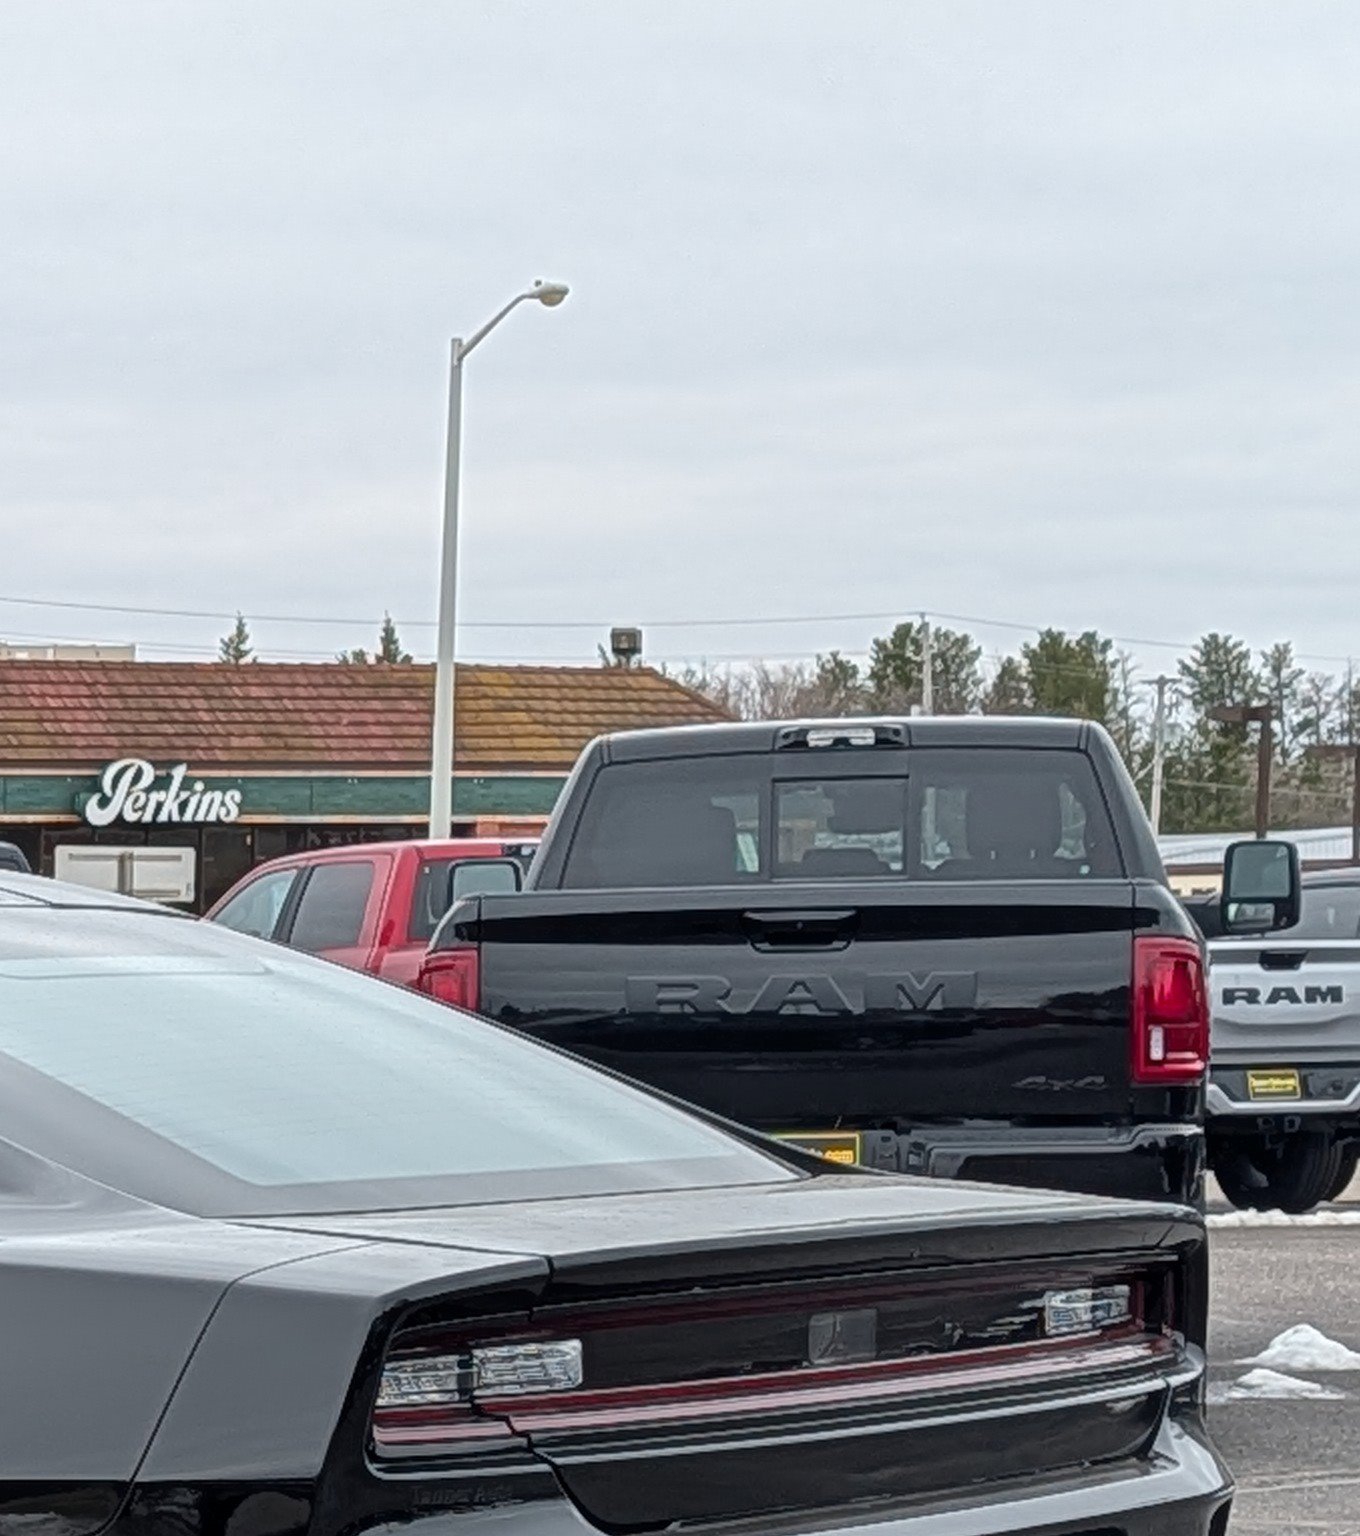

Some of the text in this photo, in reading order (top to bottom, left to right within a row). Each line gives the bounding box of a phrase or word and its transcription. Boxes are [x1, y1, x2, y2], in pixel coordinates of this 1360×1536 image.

[84, 757, 243, 827] Perkins
[625, 970, 978, 1015] RAM
[1222, 985, 1344, 1006] RAM
